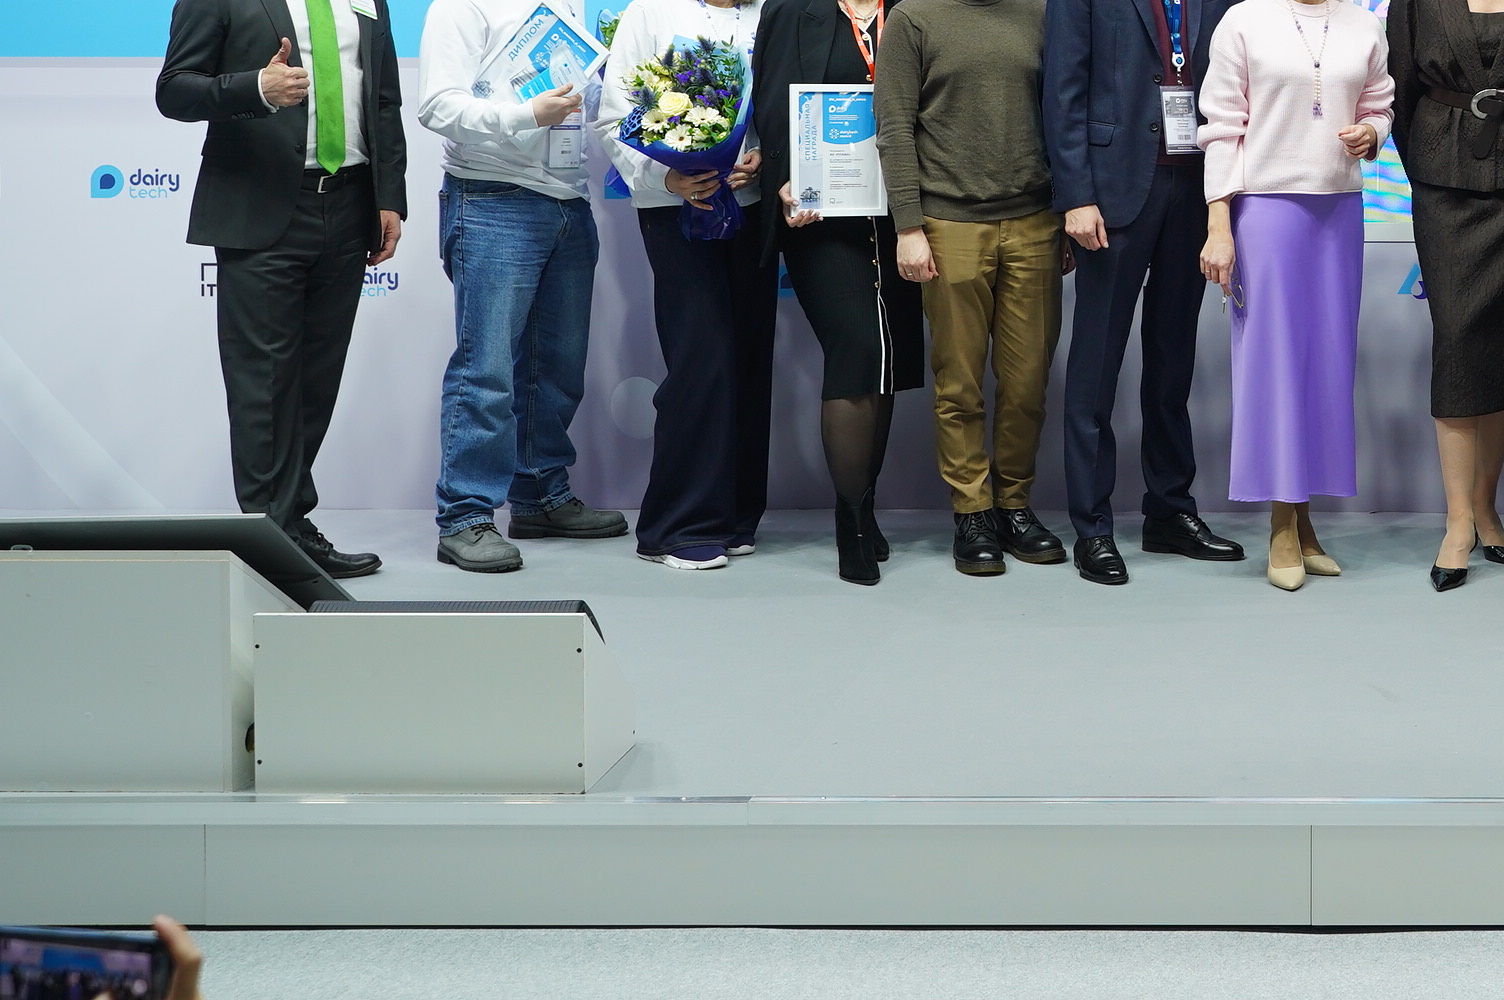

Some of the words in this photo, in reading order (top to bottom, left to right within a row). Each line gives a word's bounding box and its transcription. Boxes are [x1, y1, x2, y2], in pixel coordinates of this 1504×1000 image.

[508, 18, 545, 62] ДИПЛОМ
[129, 168, 180, 192] dairy
[129, 186, 168, 199] tech
[361, 268, 399, 290] airy
[360, 285, 387, 297] ech
